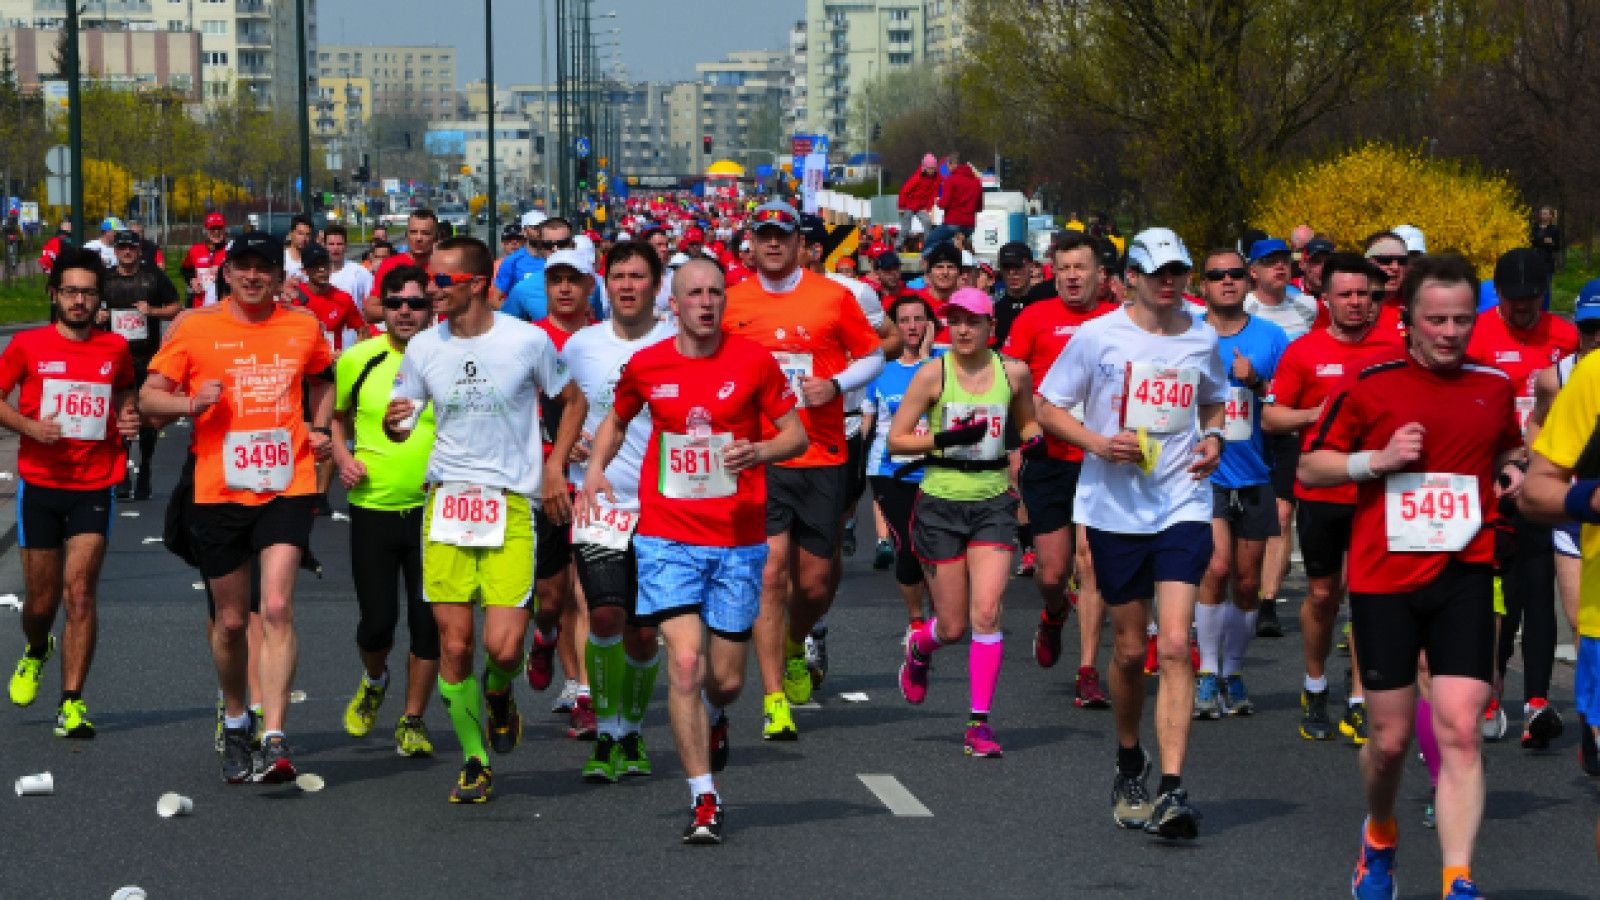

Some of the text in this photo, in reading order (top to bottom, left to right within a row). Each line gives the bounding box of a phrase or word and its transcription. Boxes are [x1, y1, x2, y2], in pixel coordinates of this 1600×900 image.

[53, 394, 105, 417] 1663
[1134, 379, 1193, 408] 4340
[1224, 400, 1249, 420] 44
[234, 442, 290, 469] 3496
[442, 495, 499, 524] 8083
[1401, 491, 1469, 520] 5491
